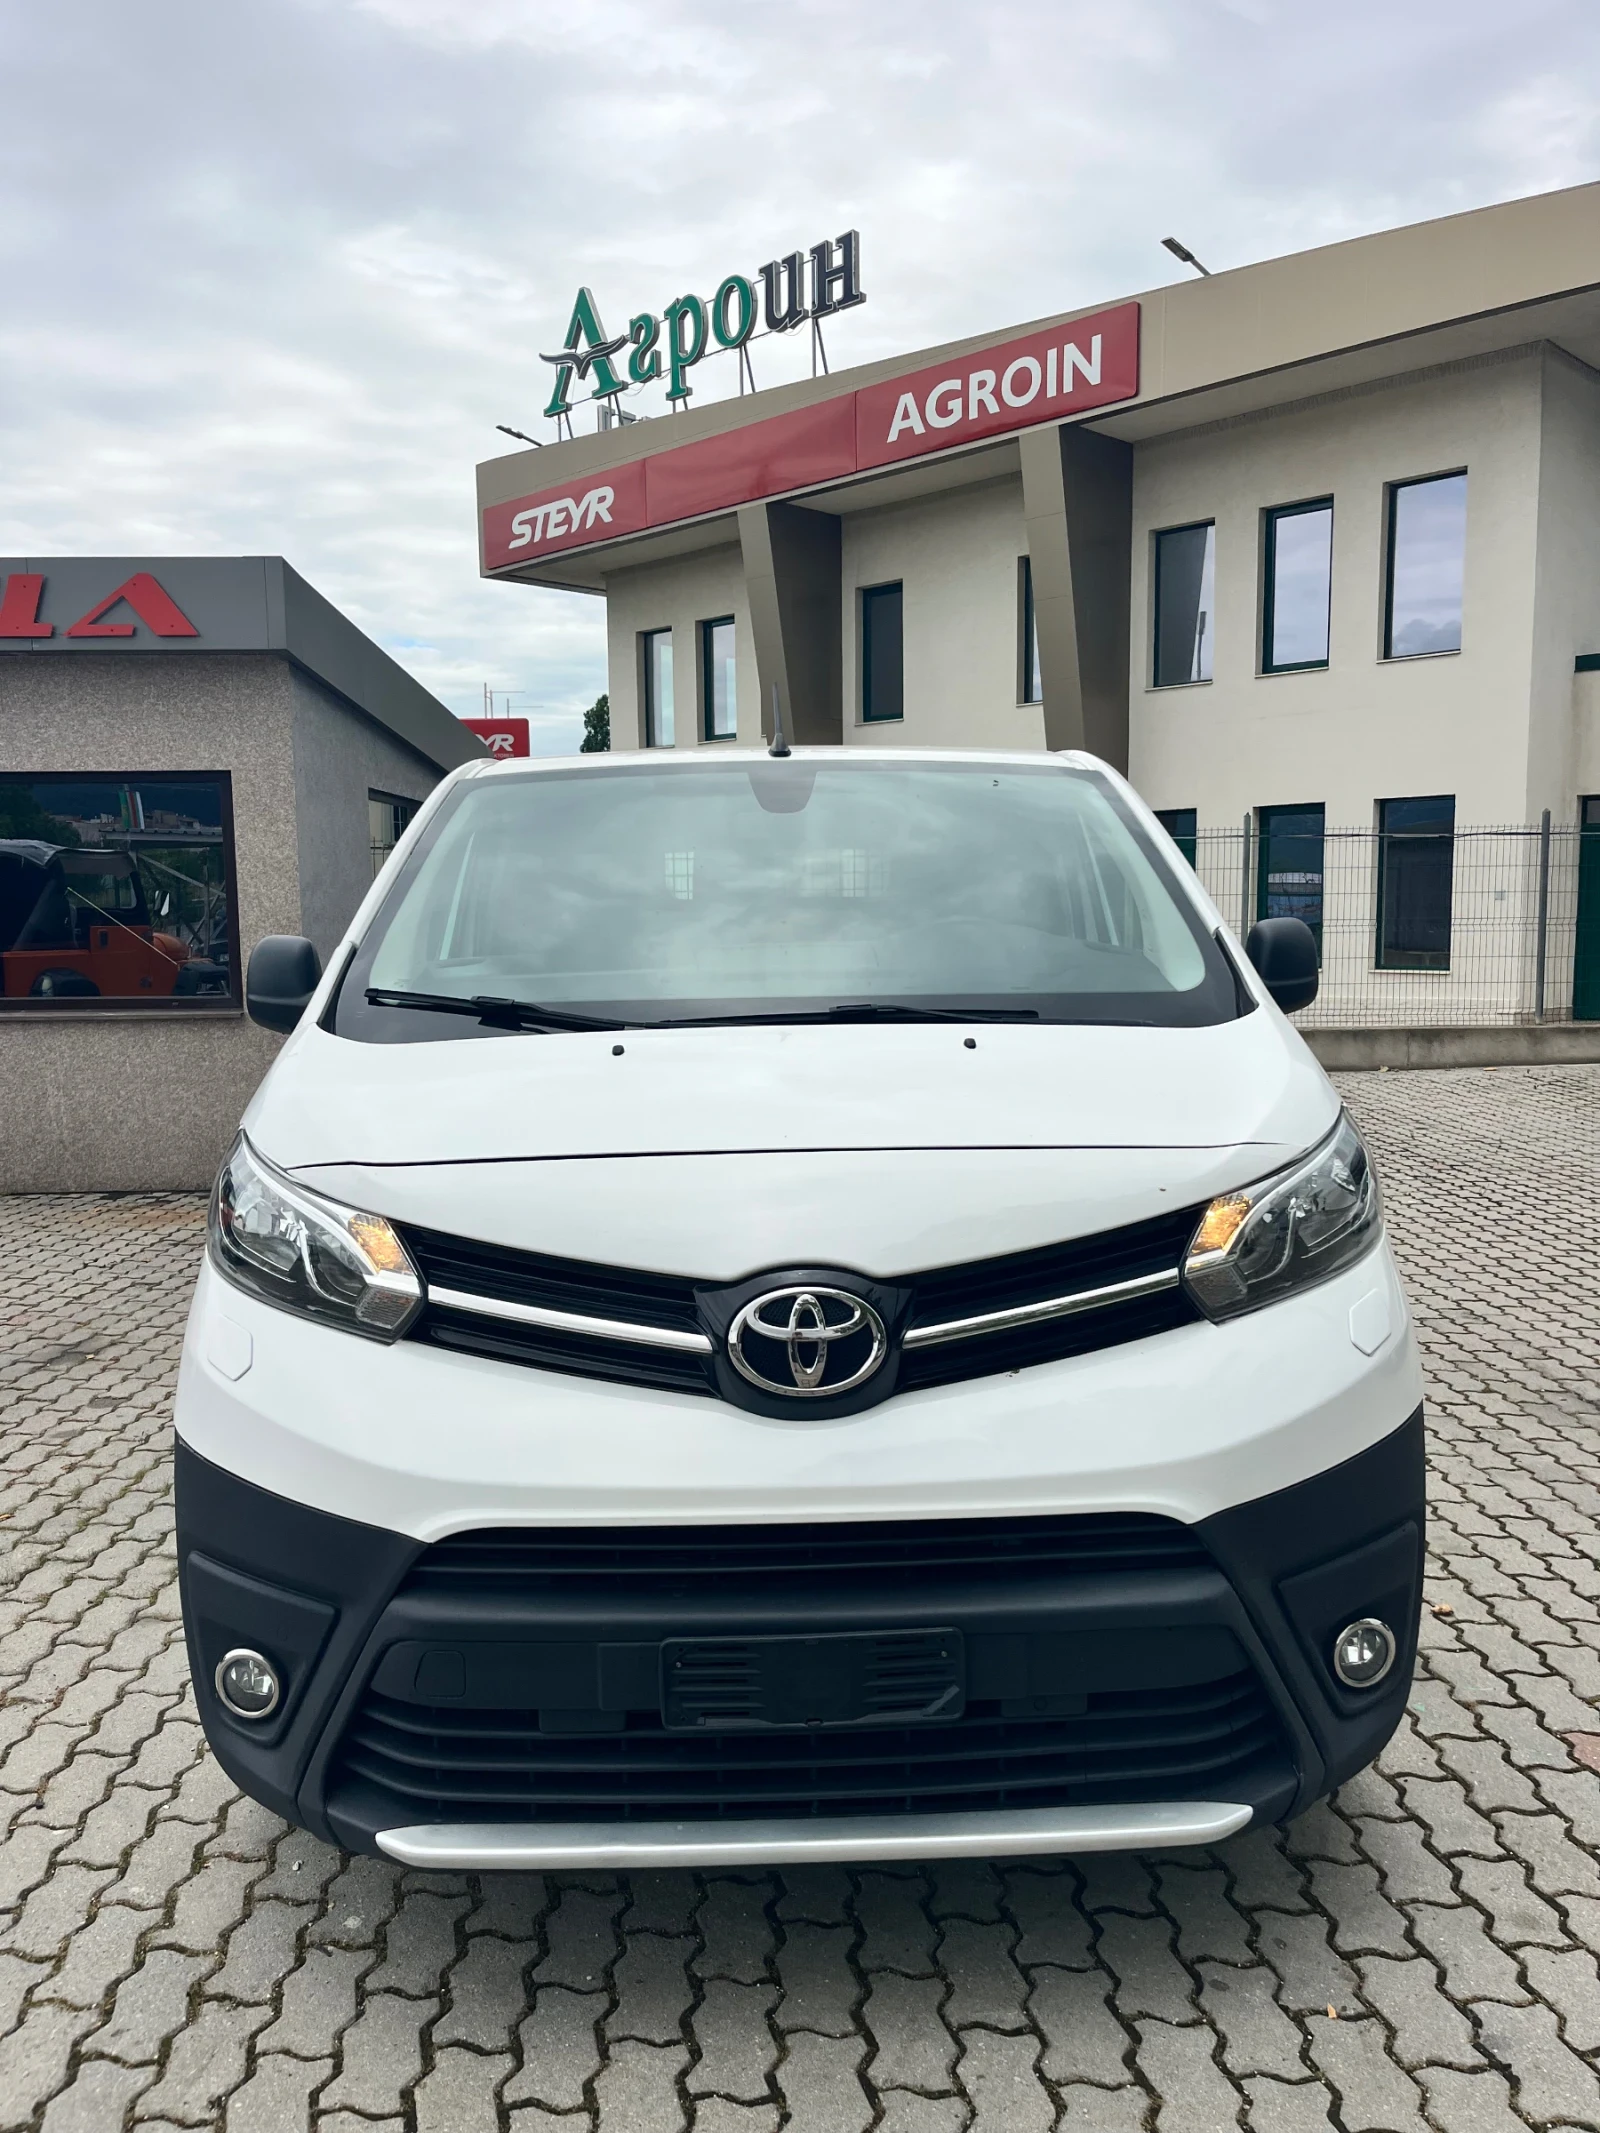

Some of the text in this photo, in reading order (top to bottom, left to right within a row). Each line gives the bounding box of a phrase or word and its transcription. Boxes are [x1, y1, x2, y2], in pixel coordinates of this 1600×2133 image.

[539, 228, 866, 418] Агроин
[886, 334, 1102, 443] AGROIN
[508, 485, 614, 549] STEYR
